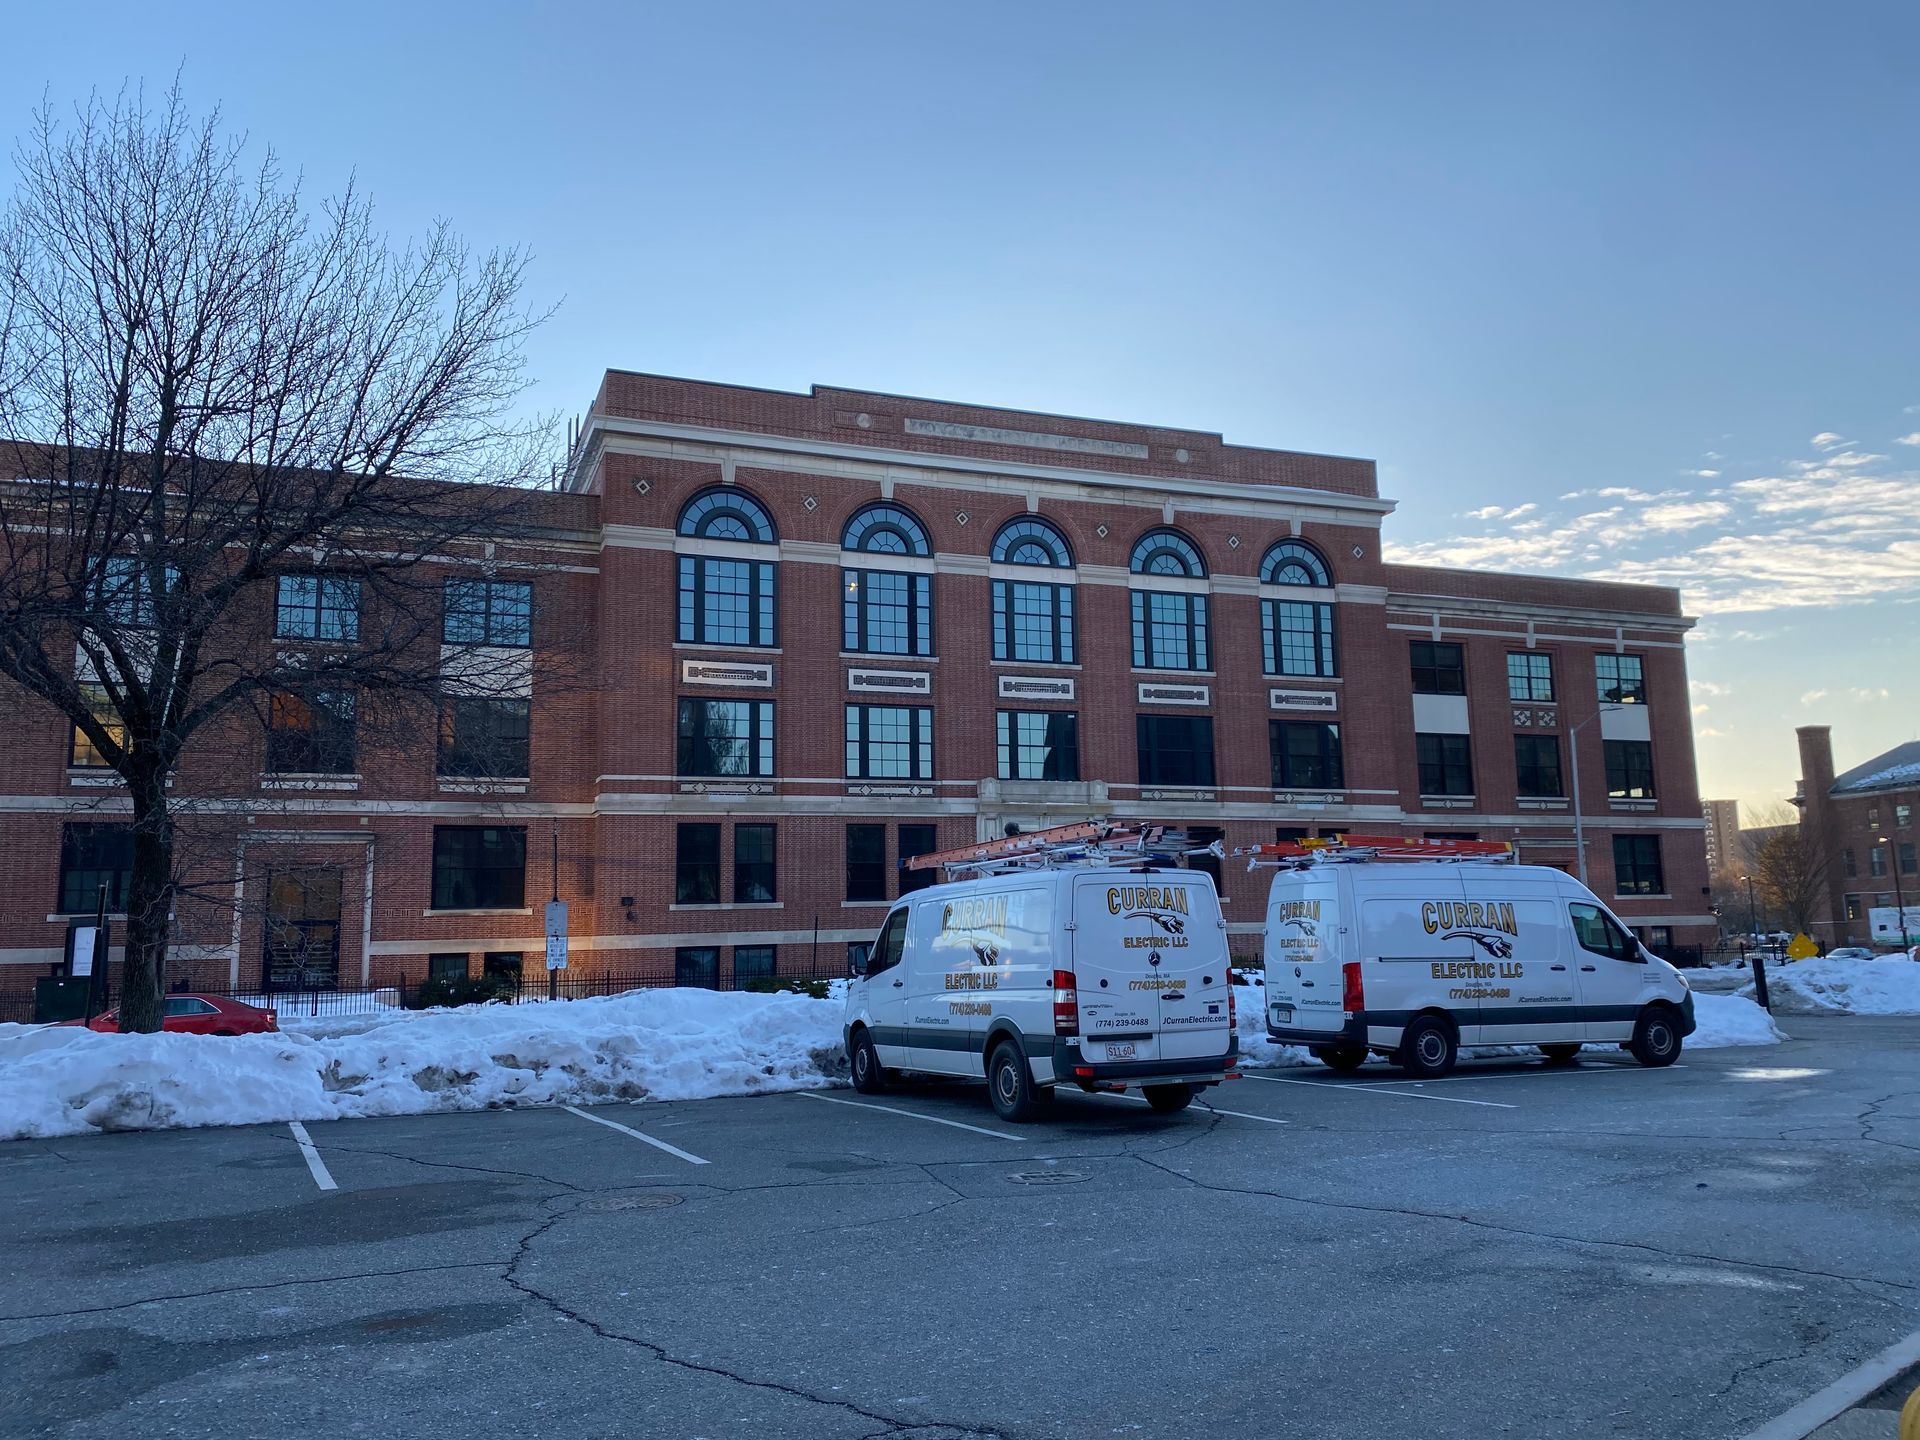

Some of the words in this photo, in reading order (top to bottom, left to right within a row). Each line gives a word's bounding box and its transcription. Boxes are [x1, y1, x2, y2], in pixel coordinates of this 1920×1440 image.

[1107, 887, 1189, 916] CURRAN
[942, 896, 1008, 940] CURRAN
[1280, 901, 1320, 923] CURRAN
[1422, 902, 1519, 937] CURRAN
[1124, 937, 1169, 948] ELECTRIC
[1172, 937, 1188, 947] LLC
[1281, 939, 1306, 948] ELECTRIC
[1307, 938, 1319, 948] LLC
[1432, 963, 1496, 979] ELECTRIC
[1500, 963, 1523, 979] LLC
[945, 973, 981, 990] ELECTRIC
[983, 972, 998, 989] LLC
[1096, 1020, 1114, 1028] (774)
[1116, 1018, 1149, 1027] 239-0488
[1163, 1015, 1227, 1025] JCurranElectric.com
